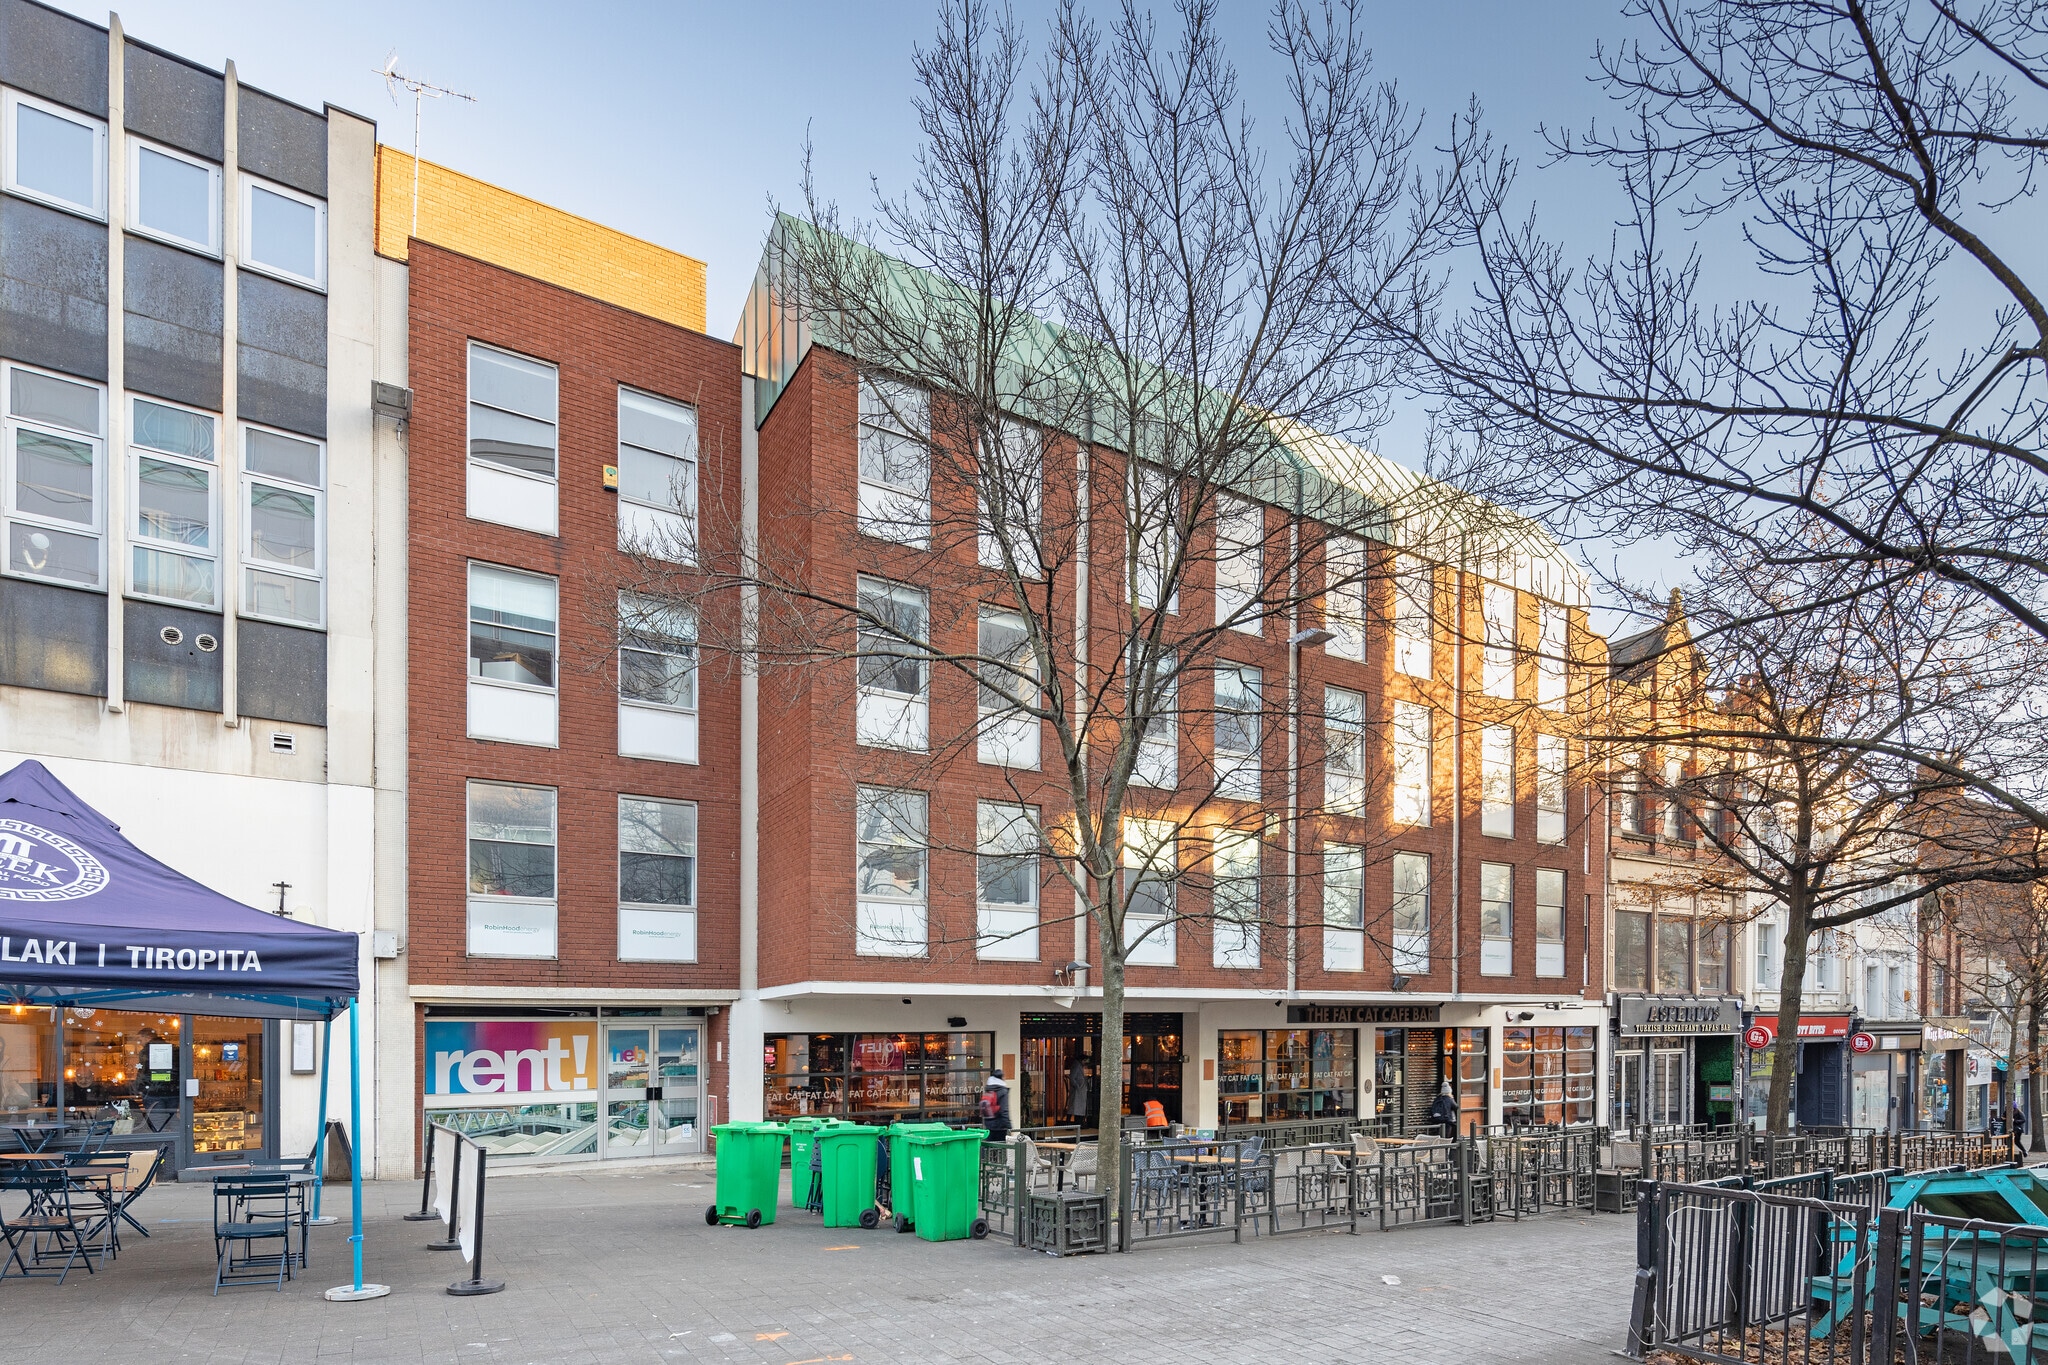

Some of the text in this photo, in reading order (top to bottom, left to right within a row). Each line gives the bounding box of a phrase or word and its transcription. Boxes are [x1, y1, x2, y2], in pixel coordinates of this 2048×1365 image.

[0, 856, 68, 885] EK
[0, 936, 77, 966] LAKI
[126, 945, 262, 972] TIROPITA
[1306, 1007, 1435, 1022] THE FAT CAT CAFE BAR
[1635, 1024, 1660, 1032] TURKISH
[1664, 1024, 1698, 1032] RESTAURANT
[435, 1035, 589, 1094] rent!
[1228, 1074, 1240, 1082] CAT
[1313, 1071, 1322, 1079] FAT
[849, 1088, 919, 1098] FAT CAT FAT CAT
[925, 1085, 985, 1095] FAT CAT FAT CA
[766, 1093, 783, 1101] FAT
[785, 1092, 803, 1101] CAT
[805, 1091, 821, 1100] FAT
